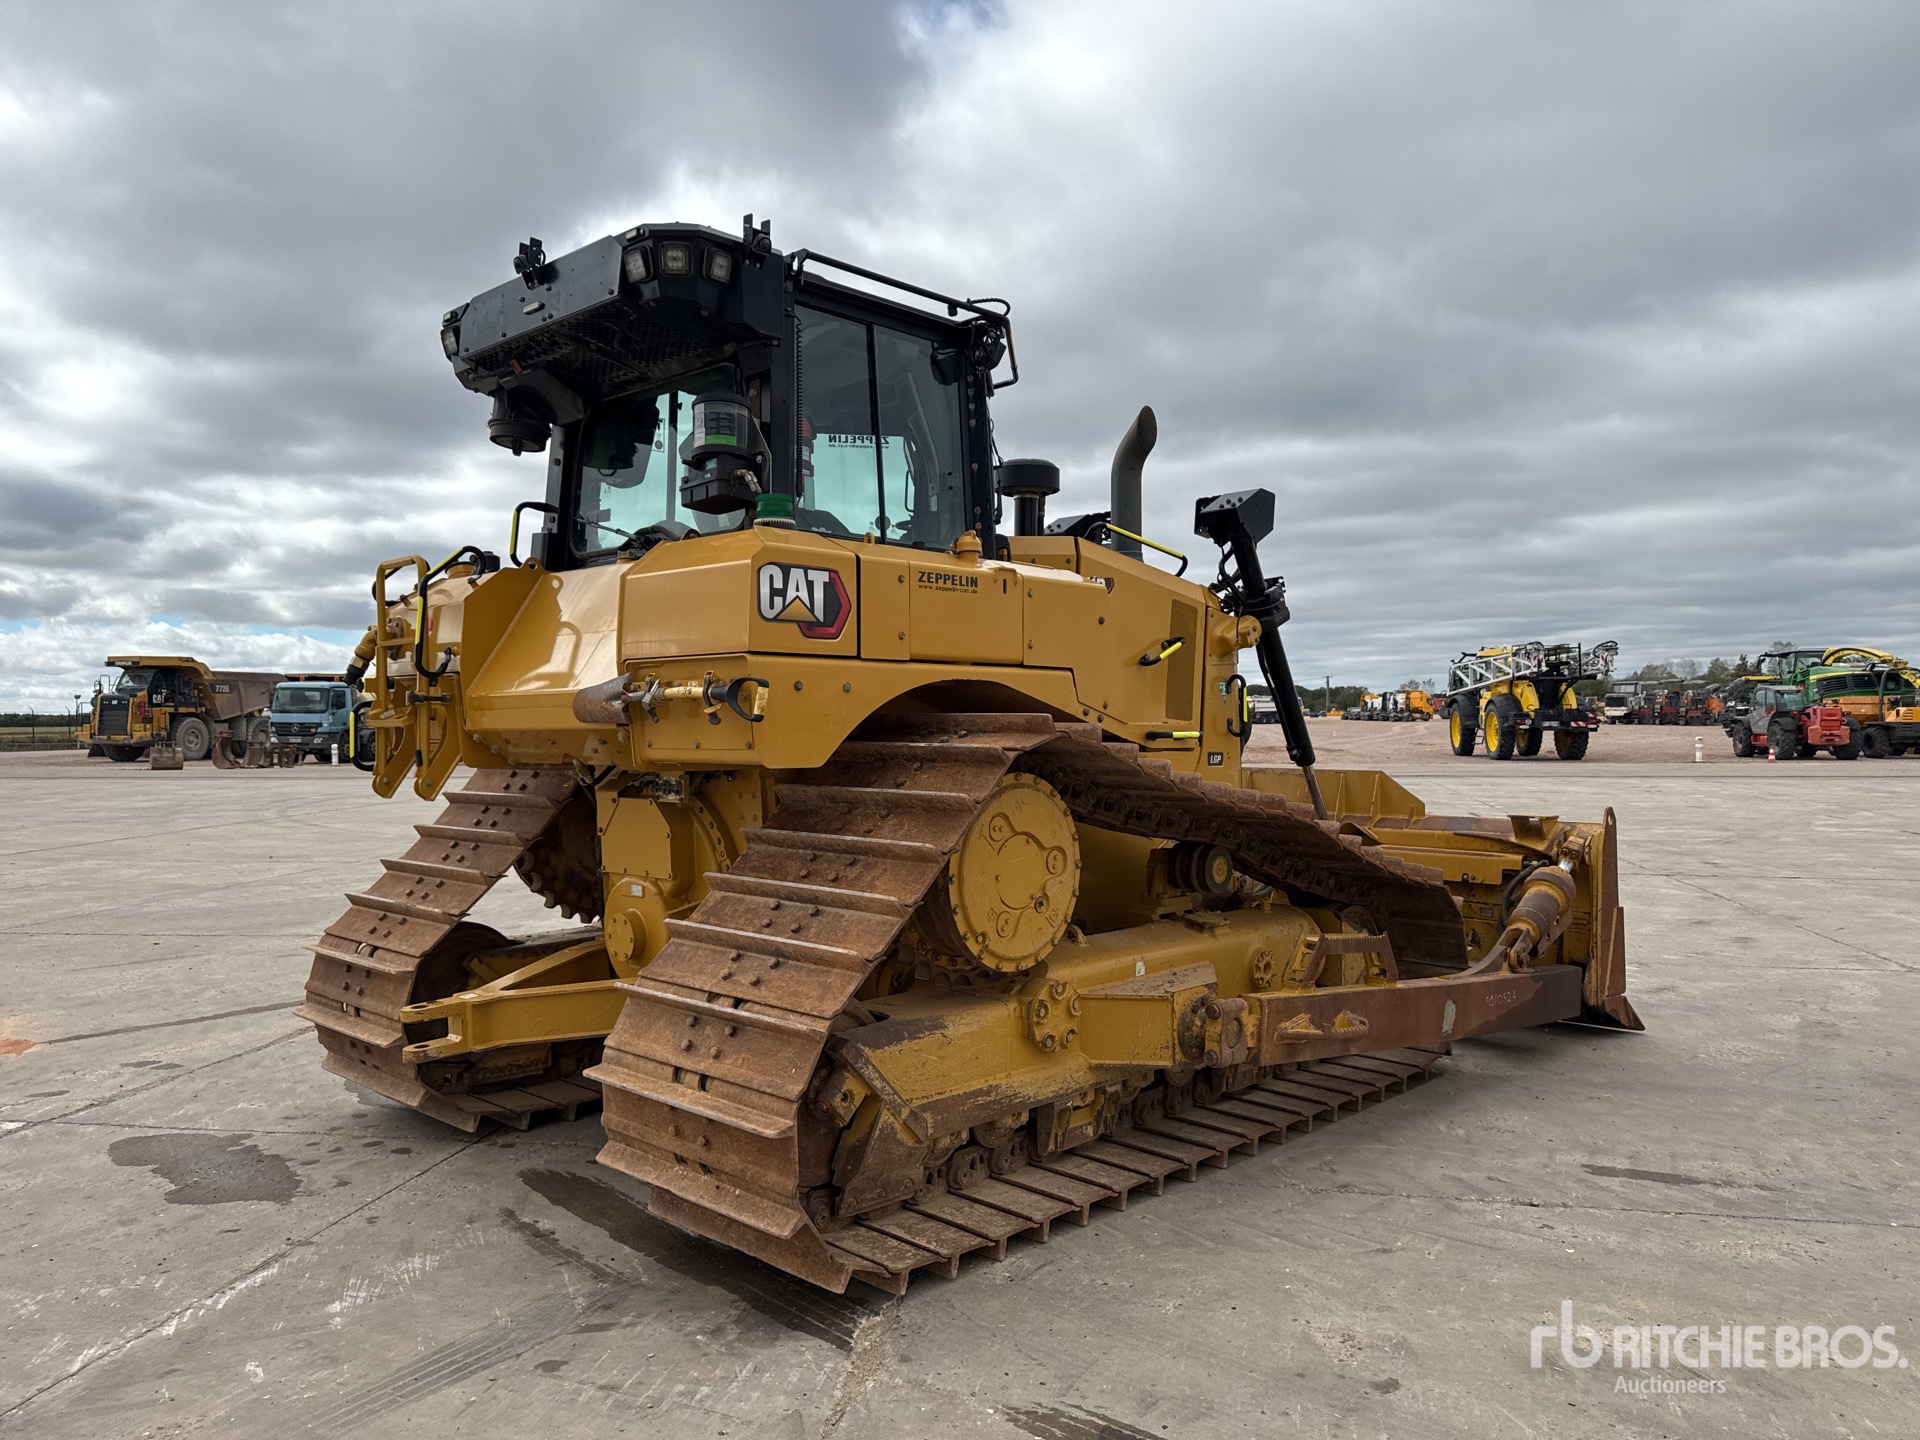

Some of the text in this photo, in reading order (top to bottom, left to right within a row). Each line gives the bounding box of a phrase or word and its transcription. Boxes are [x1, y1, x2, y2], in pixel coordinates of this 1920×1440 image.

[918, 570, 978, 588] ZEPPELIN
[760, 564, 830, 623] CAT
[152, 692, 166, 704] CAT
[1210, 755, 1222, 764] LGP
